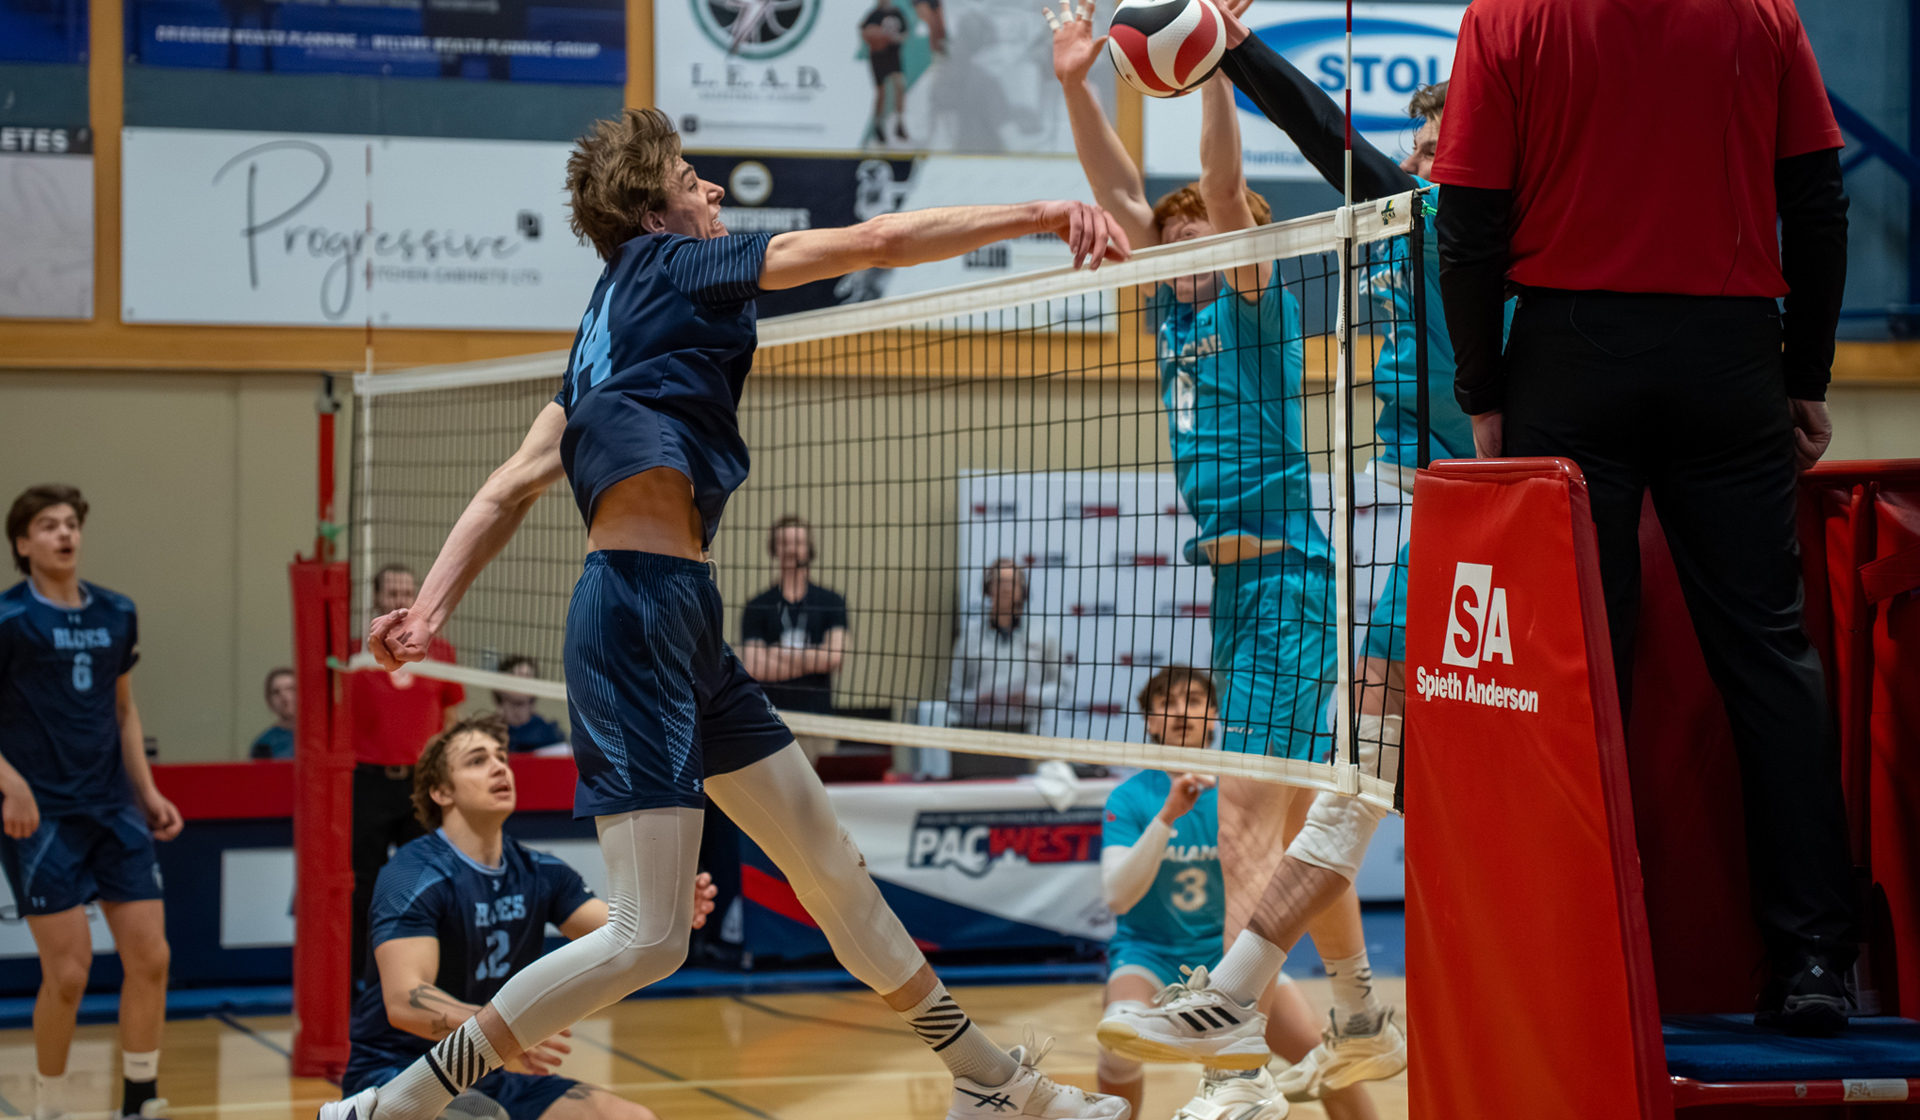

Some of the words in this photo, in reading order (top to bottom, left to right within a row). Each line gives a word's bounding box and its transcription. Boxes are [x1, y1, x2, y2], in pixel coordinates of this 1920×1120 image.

[1, 127, 68, 153] ETES
[211, 139, 520, 321] Progressive
[72, 652, 92, 691] 6
[1416, 666, 1462, 702] Spieth
[1465, 674, 1539, 713] Anderson
[1172, 868, 1207, 911] 3
